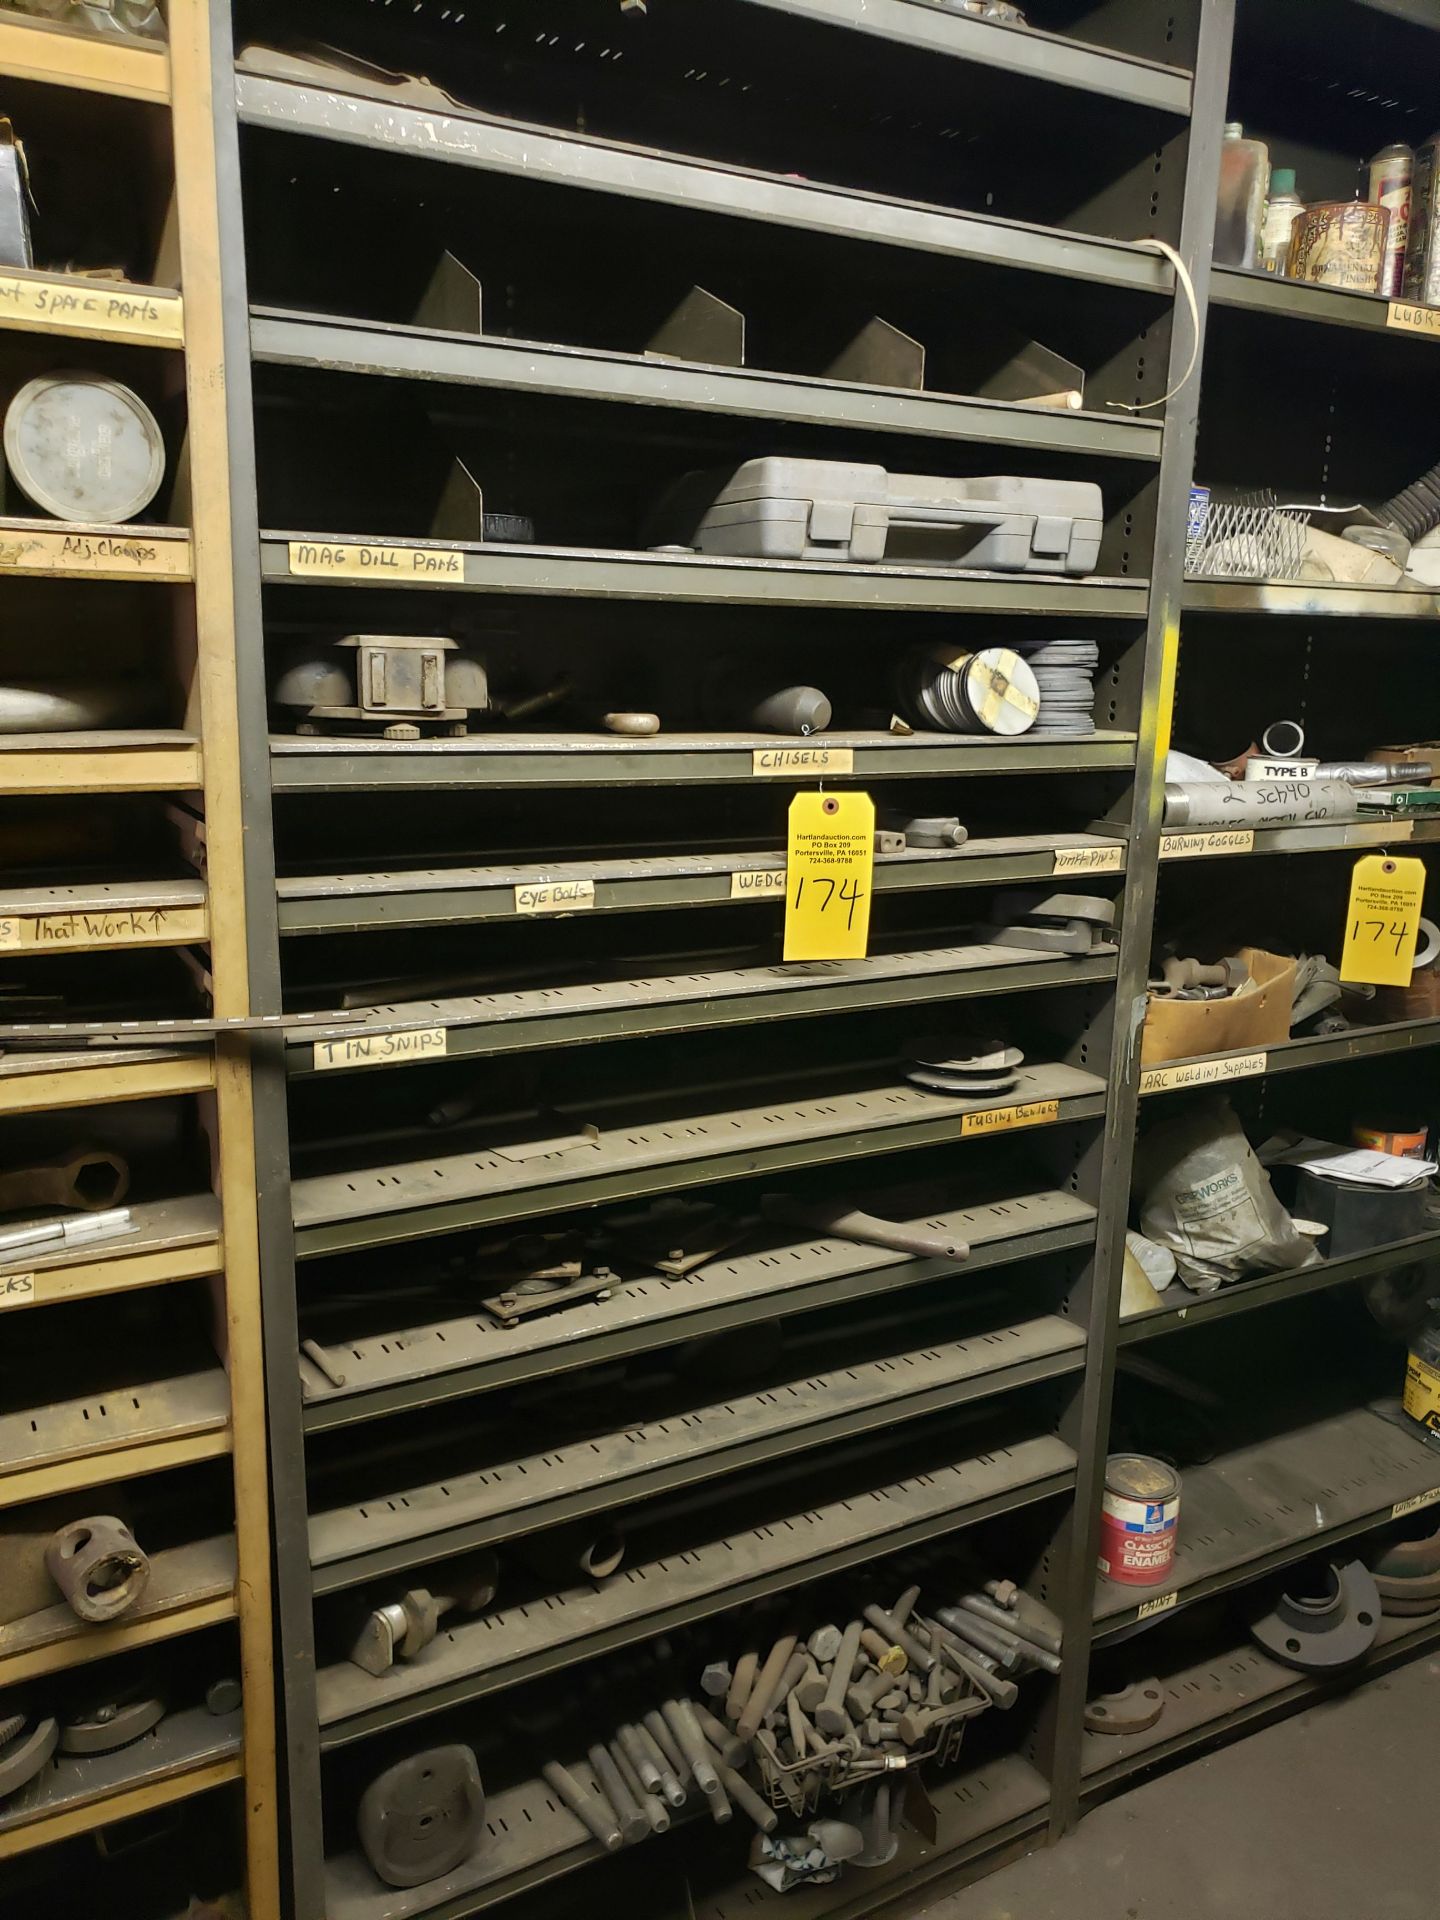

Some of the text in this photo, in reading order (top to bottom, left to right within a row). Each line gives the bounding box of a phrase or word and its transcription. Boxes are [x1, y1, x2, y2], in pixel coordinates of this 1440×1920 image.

[298, 545, 346, 565] MAG
[760, 751, 830, 768] CHISELS
[1264, 765, 1308, 777] TYPE B
[796, 833, 867, 841] Hartlandauction.com
[1208, 833, 1251, 847] GOGGLES
[795, 849, 835, 857] Portersville,
[739, 873, 788, 889] WEDG
[519, 889, 548, 908] EYE
[795, 877, 864, 931] 174
[35, 913, 146, 941] That Work
[1353, 920, 1409, 957] 174
[322, 1030, 444, 1064] TIN SNIPS
[1145, 1073, 1169, 1089] ARC
[1123, 1553, 1171, 1567] ENAMEL
